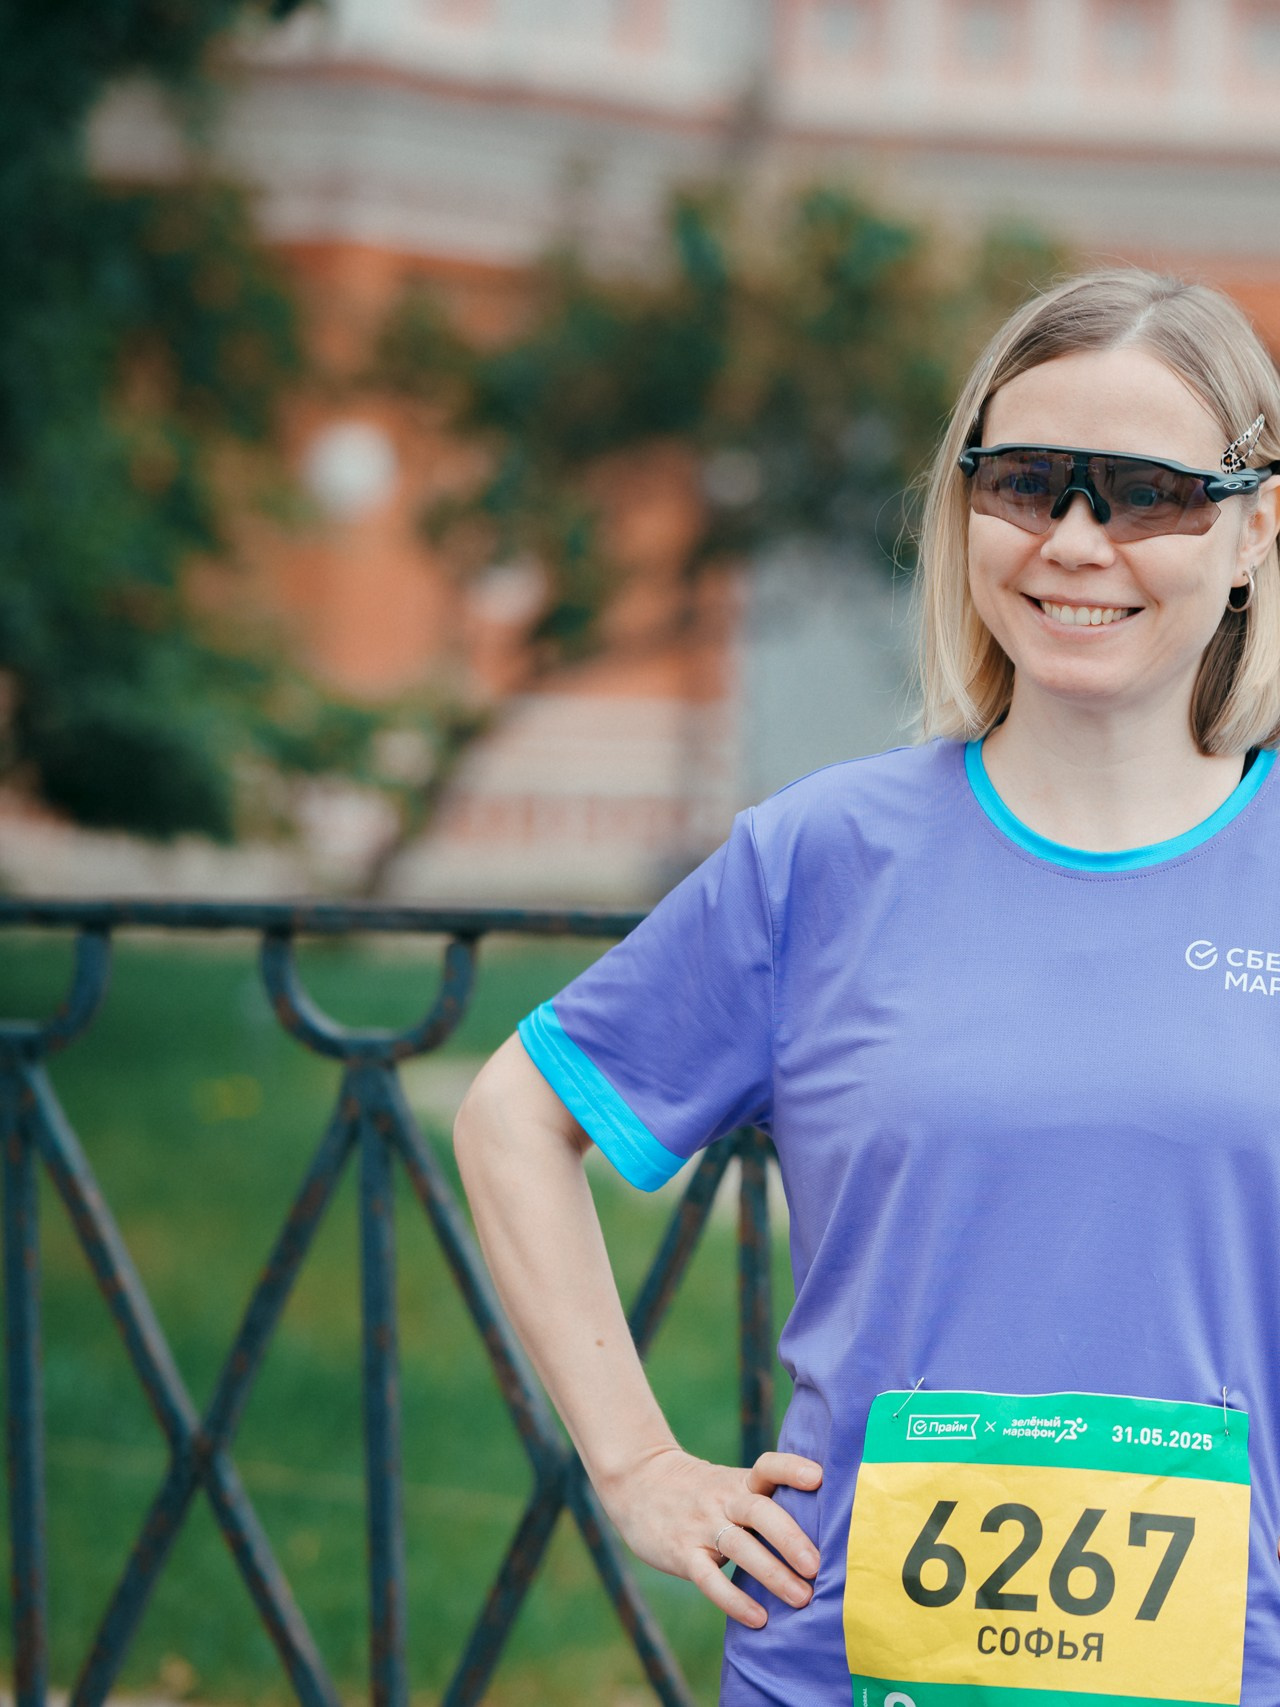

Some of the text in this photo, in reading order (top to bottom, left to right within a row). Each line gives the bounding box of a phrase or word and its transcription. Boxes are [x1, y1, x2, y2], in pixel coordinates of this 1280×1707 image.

[929, 1421, 968, 1434] Прайм
[1011, 1416, 1061, 1428] зелёный
[1002, 1427, 1055, 1439] марафон
[1111, 1425, 1213, 1451] 31.05.2025
[901, 1500, 1196, 1622] 6267
[977, 1625, 1105, 1663] СОФЬЯ
